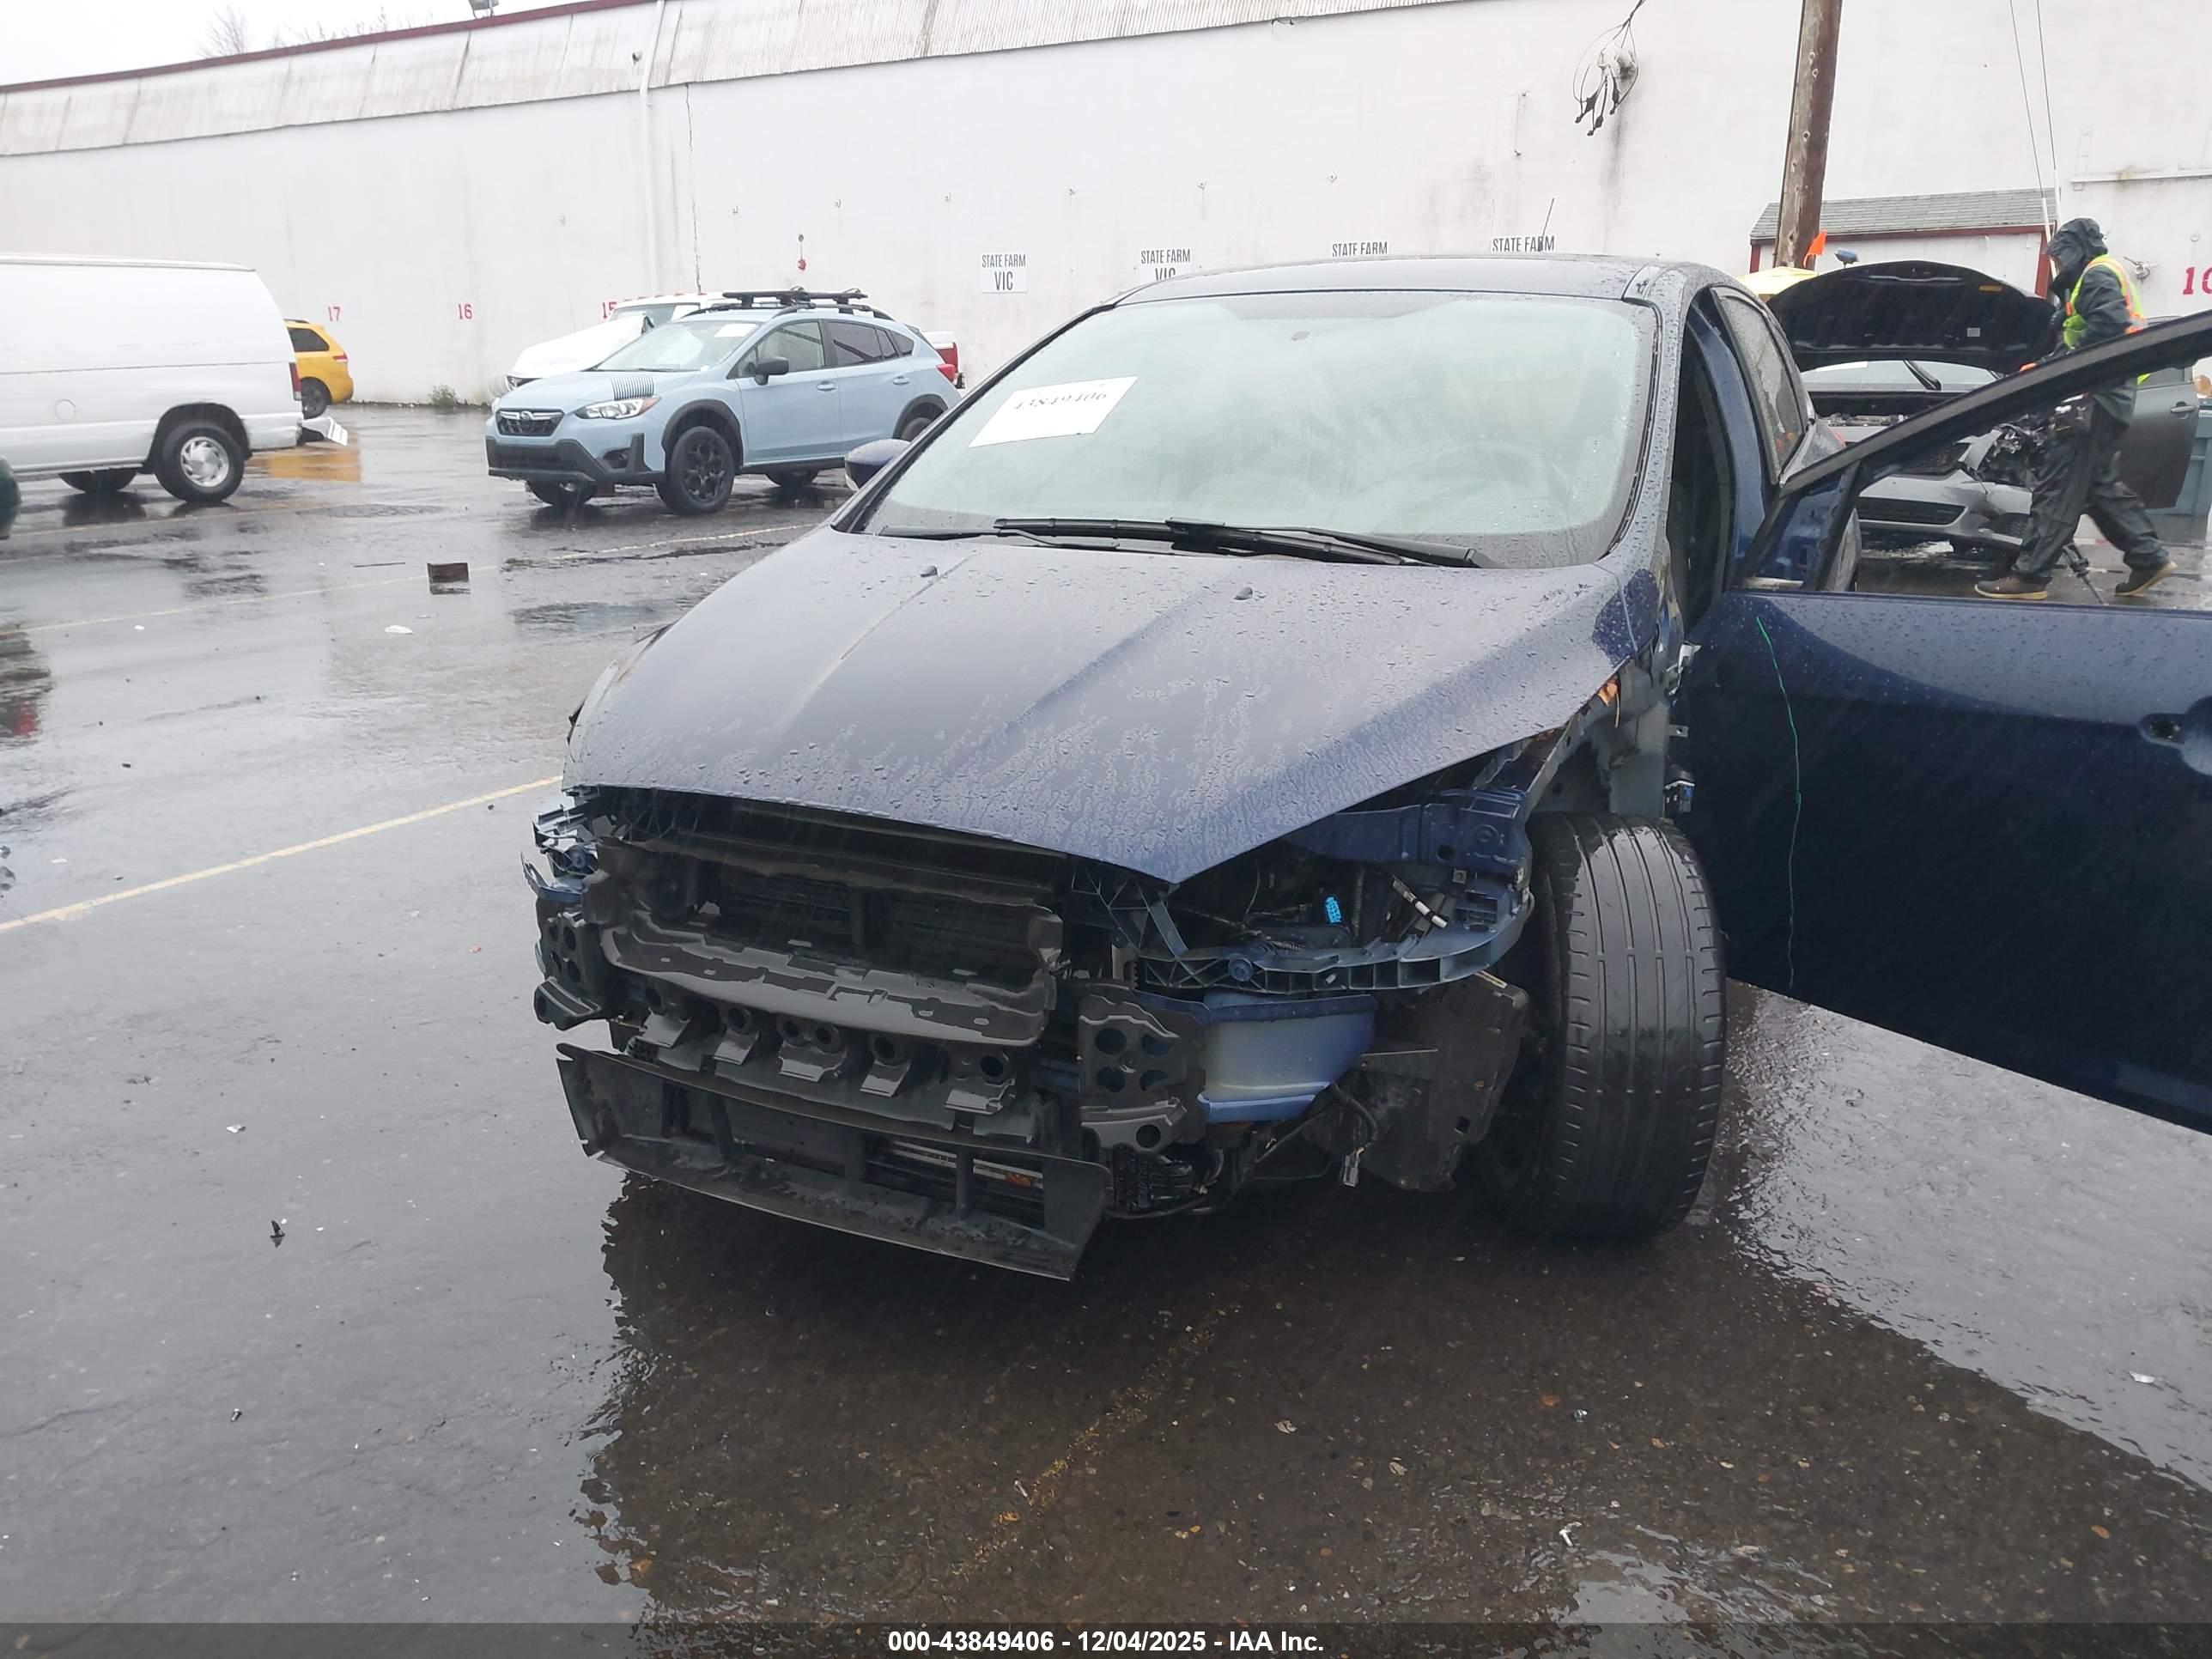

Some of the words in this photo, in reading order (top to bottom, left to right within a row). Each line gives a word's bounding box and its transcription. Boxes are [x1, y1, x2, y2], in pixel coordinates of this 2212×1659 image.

[1332, 242, 1358, 258] STATE
[1360, 240, 1388, 255] FARM
[1492, 237, 1522, 252] STATE
[1524, 235, 1555, 252] FARM
[981, 254, 1003, 268] STATE
[1004, 253, 1026, 267] FARM
[1140, 249, 1165, 264] STATE
[1166, 248, 1191, 263] FARM
[994, 270, 1013, 291] VIC
[327, 306, 341, 322] 17
[458, 303, 473, 319] 16
